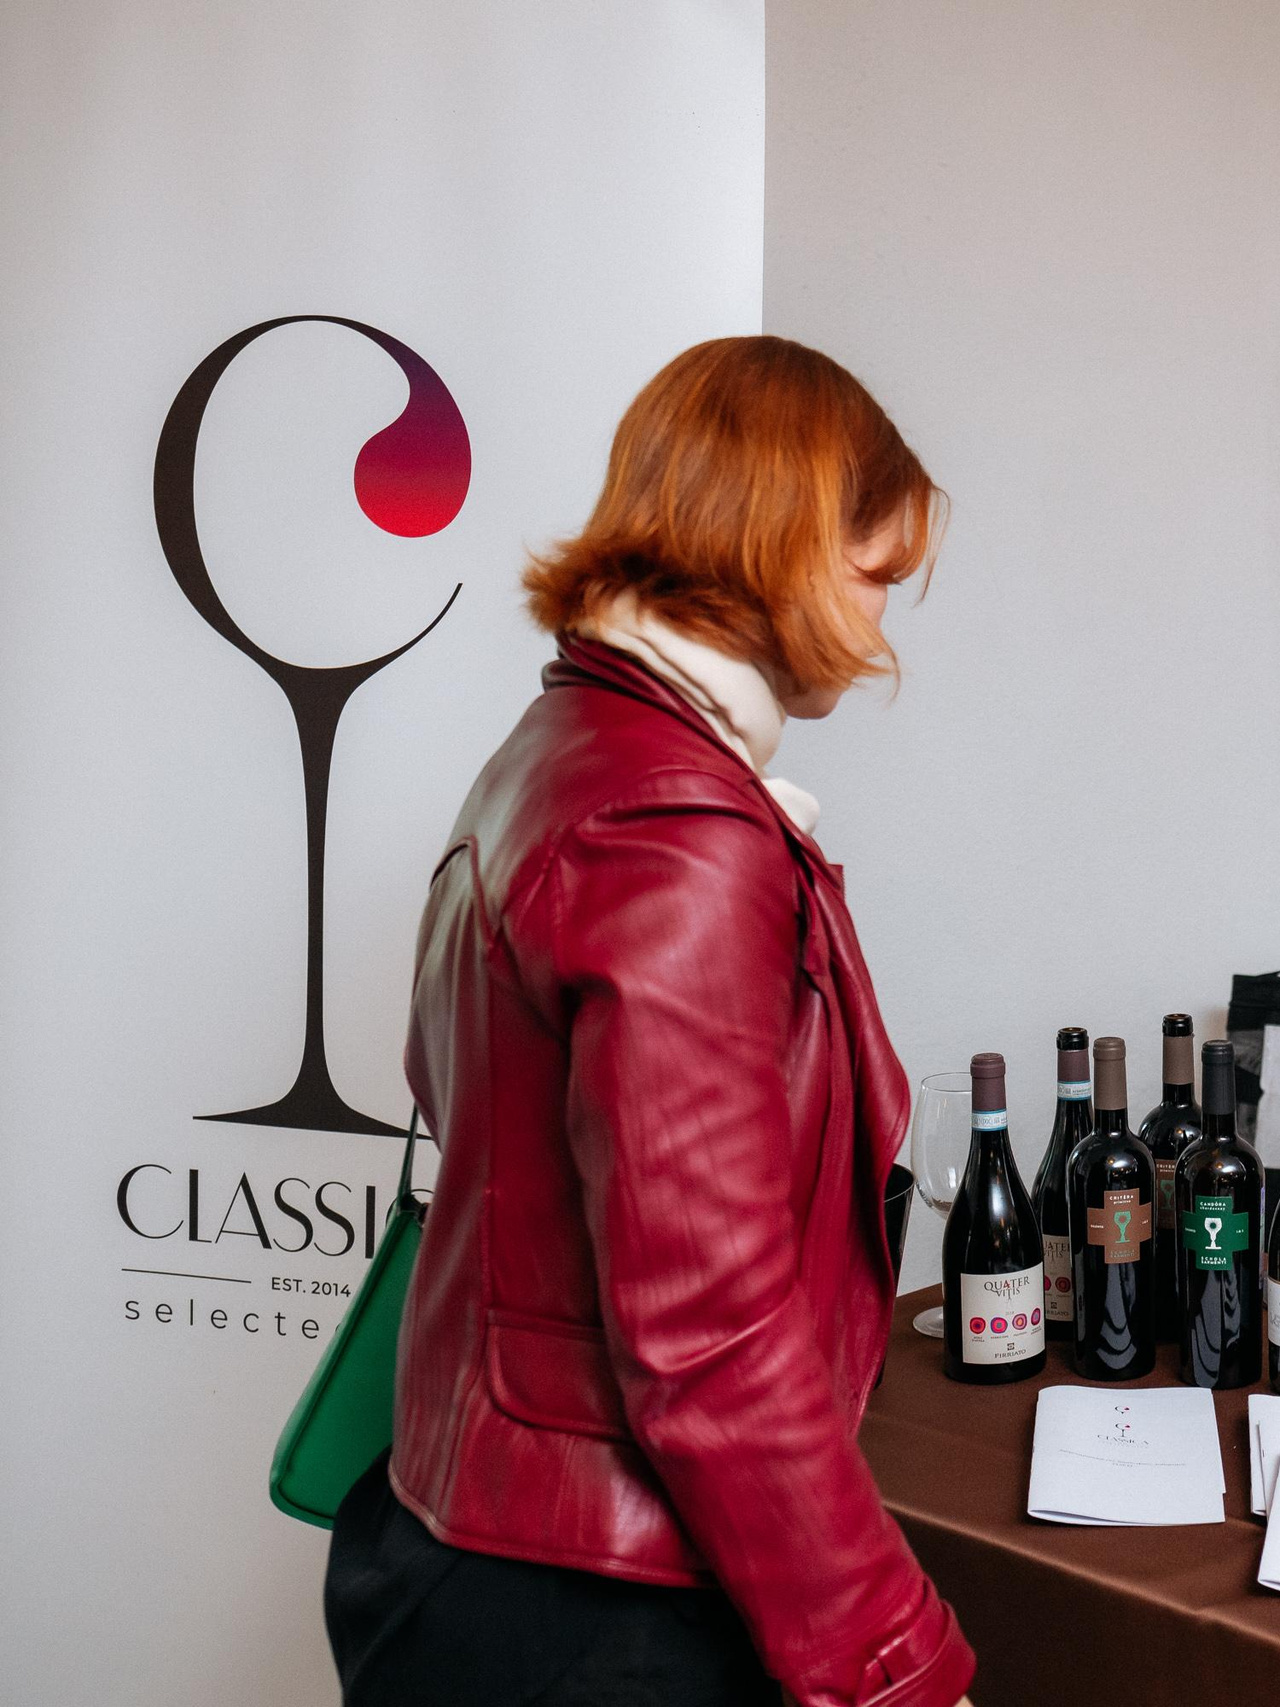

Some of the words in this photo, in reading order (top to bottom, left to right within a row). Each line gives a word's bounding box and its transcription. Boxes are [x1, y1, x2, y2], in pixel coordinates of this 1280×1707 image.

[117, 1164, 434, 1259] CLASSI
[271, 1277, 307, 1293] EST.
[311, 1281, 351, 1298] 2014
[125, 1299, 341, 1339] selecte
[994, 1349, 1026, 1359] FIRRIATO
